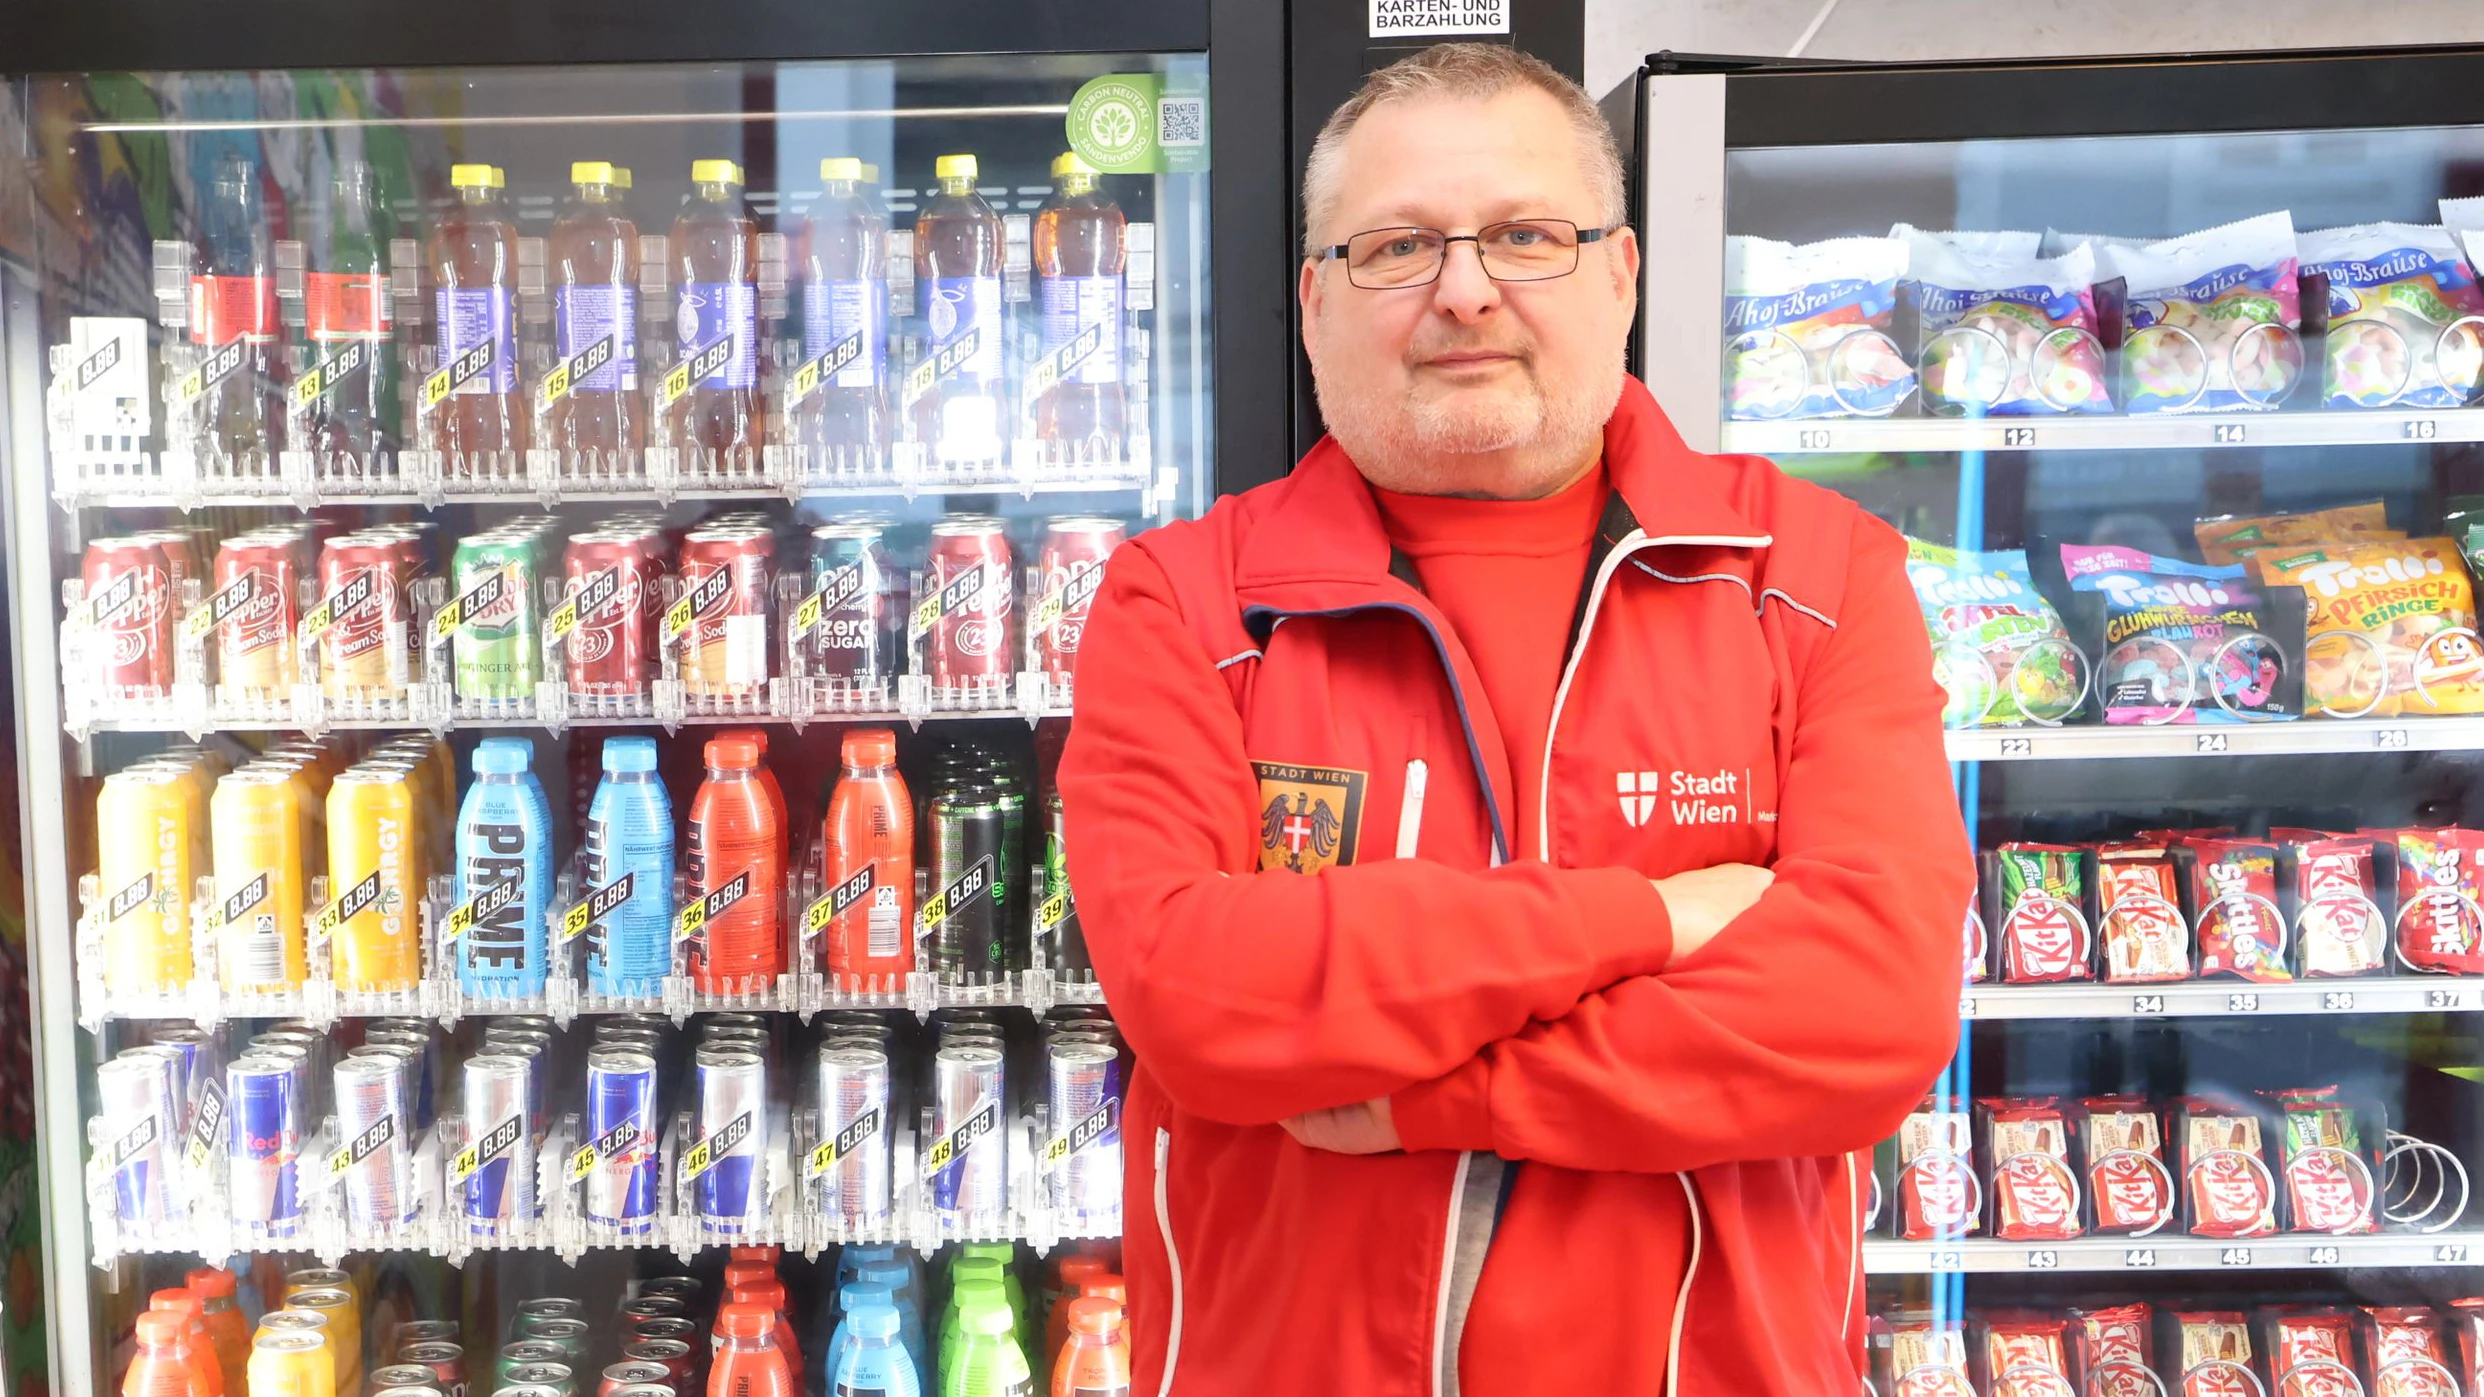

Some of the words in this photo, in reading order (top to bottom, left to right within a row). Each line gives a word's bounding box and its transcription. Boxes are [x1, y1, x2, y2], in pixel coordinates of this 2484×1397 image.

[1376, 13, 1501, 28] BARZAHLUNG
[1377, 0, 1458, 13] KARTEN-
[1463, 0, 1500, 11] UND
[1077, 86, 1111, 121] CARBON
[1112, 86, 1149, 121] NEUTRAL
[1080, 136, 1147, 163] SANDENVENDO
[82, 342, 117, 386] 8.88
[181, 376, 197, 400] 12
[206, 344, 240, 385] 8.88
[300, 375, 317, 400] 13
[326, 344, 360, 385] 8.88
[428, 373, 448, 399] 14
[455, 342, 490, 384] 8.88
[547, 372, 566, 398] 15
[573, 339, 608, 380] 8.88
[667, 371, 685, 396] 16
[694, 338, 729, 379] 8.88
[797, 366, 814, 392] 17
[823, 335, 857, 377] 8.88
[914, 366, 931, 390] 18
[939, 332, 974, 375] 8.88
[1036, 363, 1053, 387] 19
[1061, 328, 1096, 371] 8.88
[1803, 431, 1828, 448] 10
[2007, 429, 2033, 446] 12
[2217, 426, 2243, 442] 14
[2408, 422, 2434, 438] 16
[799, 600, 818, 626] 27
[825, 567, 858, 611] 8.88
[1041, 598, 1060, 625] 29
[1067, 566, 1101, 607] 8.88
[2095, 575, 2229, 607] Trolli
[2298, 555, 2443, 597] Trolli
[97, 578, 131, 621] 8.88
[190, 611, 209, 635] 22
[215, 577, 249, 619] 8.88
[308, 608, 328, 635] 23
[334, 576, 367, 618] 8.88
[438, 608, 457, 634] 24
[464, 577, 499, 618] 8.88
[555, 608, 574, 634] 25
[580, 573, 613, 615] 8.88
[671, 607, 690, 633] 26
[695, 570, 727, 612] 8.88
[920, 601, 939, 627] 28
[945, 568, 979, 611] 8.88
[704, 621, 727, 641] Sod
[821, 620, 875, 637] zero
[1060, 624, 1080, 644] 23
[2193, 624, 2225, 640] ROT
[467, 663, 512, 674] GINGER
[2267, 703, 2285, 713] 150g
[2003, 740, 2031, 755] 22
[2199, 736, 2226, 750] 24
[2380, 731, 2406, 747] 26
[1261, 765, 1306, 779] STADT
[1313, 771, 1350, 784] WIEN
[1670, 769, 1737, 796] Stadt
[874, 805, 888, 838] PRIME
[1671, 799, 1738, 825] Wien
[114, 877, 148, 917] 8.88
[204, 909, 223, 934] 32
[230, 878, 262, 919] 8.88
[318, 912, 337, 936] 33
[343, 877, 375, 917] 8.88
[451, 909, 470, 933] 34
[477, 880, 511, 920] 8.88
[566, 908, 585, 933] 35
[594, 877, 628, 918] 8.88
[683, 908, 702, 933] 36
[710, 877, 743, 917] 8.88
[811, 901, 831, 927] 37
[837, 868, 870, 909] 8.88
[924, 899, 944, 924] 38
[950, 867, 983, 908] 8.88
[1042, 898, 1063, 924] 39
[2209, 862, 2260, 969] Skittles
[2311, 866, 2366, 942] KitKat
[2428, 849, 2466, 957] Skittles
[2017, 892, 2071, 963] KitKat
[2347, 944, 2361, 969] WHITE
[1960, 1000, 1975, 1014] 2
[2136, 997, 2162, 1012] 34
[2230, 996, 2257, 1010] 35
[2326, 994, 2352, 1009] 36
[2432, 992, 2459, 1007] 37
[199, 1092, 220, 1143] 8.88
[1048, 1138, 1067, 1160] 49
[1075, 1108, 1108, 1148] 8.88
[120, 1119, 152, 1159] 8.88
[247, 1130, 281, 1150] Red
[332, 1149, 350, 1173] 43
[357, 1119, 389, 1159] 8.88
[456, 1150, 477, 1174] 44
[484, 1120, 516, 1159] 8.88
[575, 1148, 594, 1173] 45
[602, 1122, 635, 1157] 8.88
[688, 1149, 707, 1173] 46
[715, 1114, 747, 1155] 8.88
[815, 1143, 833, 1169] 47
[841, 1114, 874, 1151] 8.88
[931, 1141, 950, 1165] 48
[957, 1112, 990, 1151] 8.88
[1931, 1252, 1958, 1268] 42
[2030, 1252, 2056, 1267] 43
[2127, 1250, 2154, 1266] 44
[2222, 1249, 2249, 1264] 45
[2310, 1248, 2337, 1263] 46
[2437, 1245, 2464, 1261] 47
